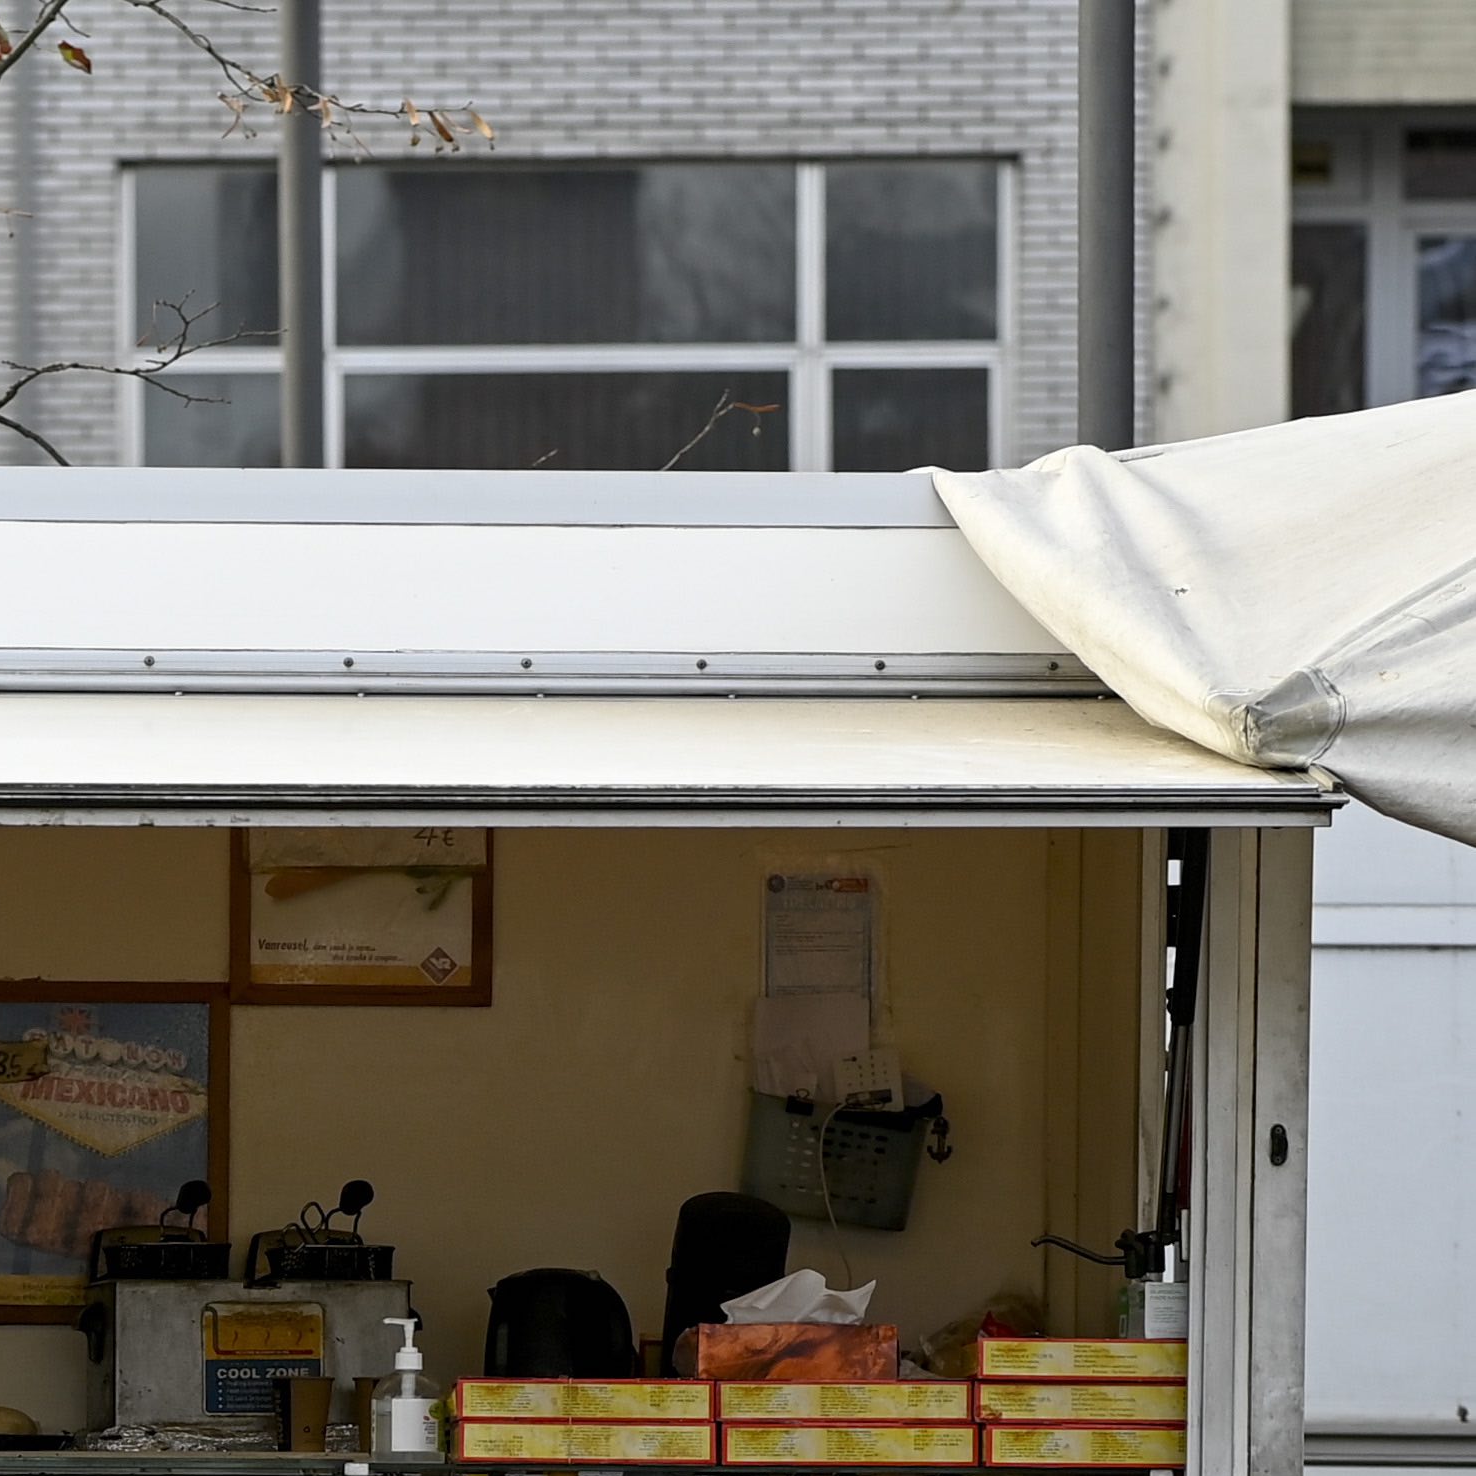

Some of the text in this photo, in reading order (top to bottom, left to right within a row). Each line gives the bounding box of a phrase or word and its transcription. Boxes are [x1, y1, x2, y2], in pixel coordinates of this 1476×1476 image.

[19, 1075, 192, 1114] MEXICANO
[216, 1367, 310, 1379] COOL ZONE
